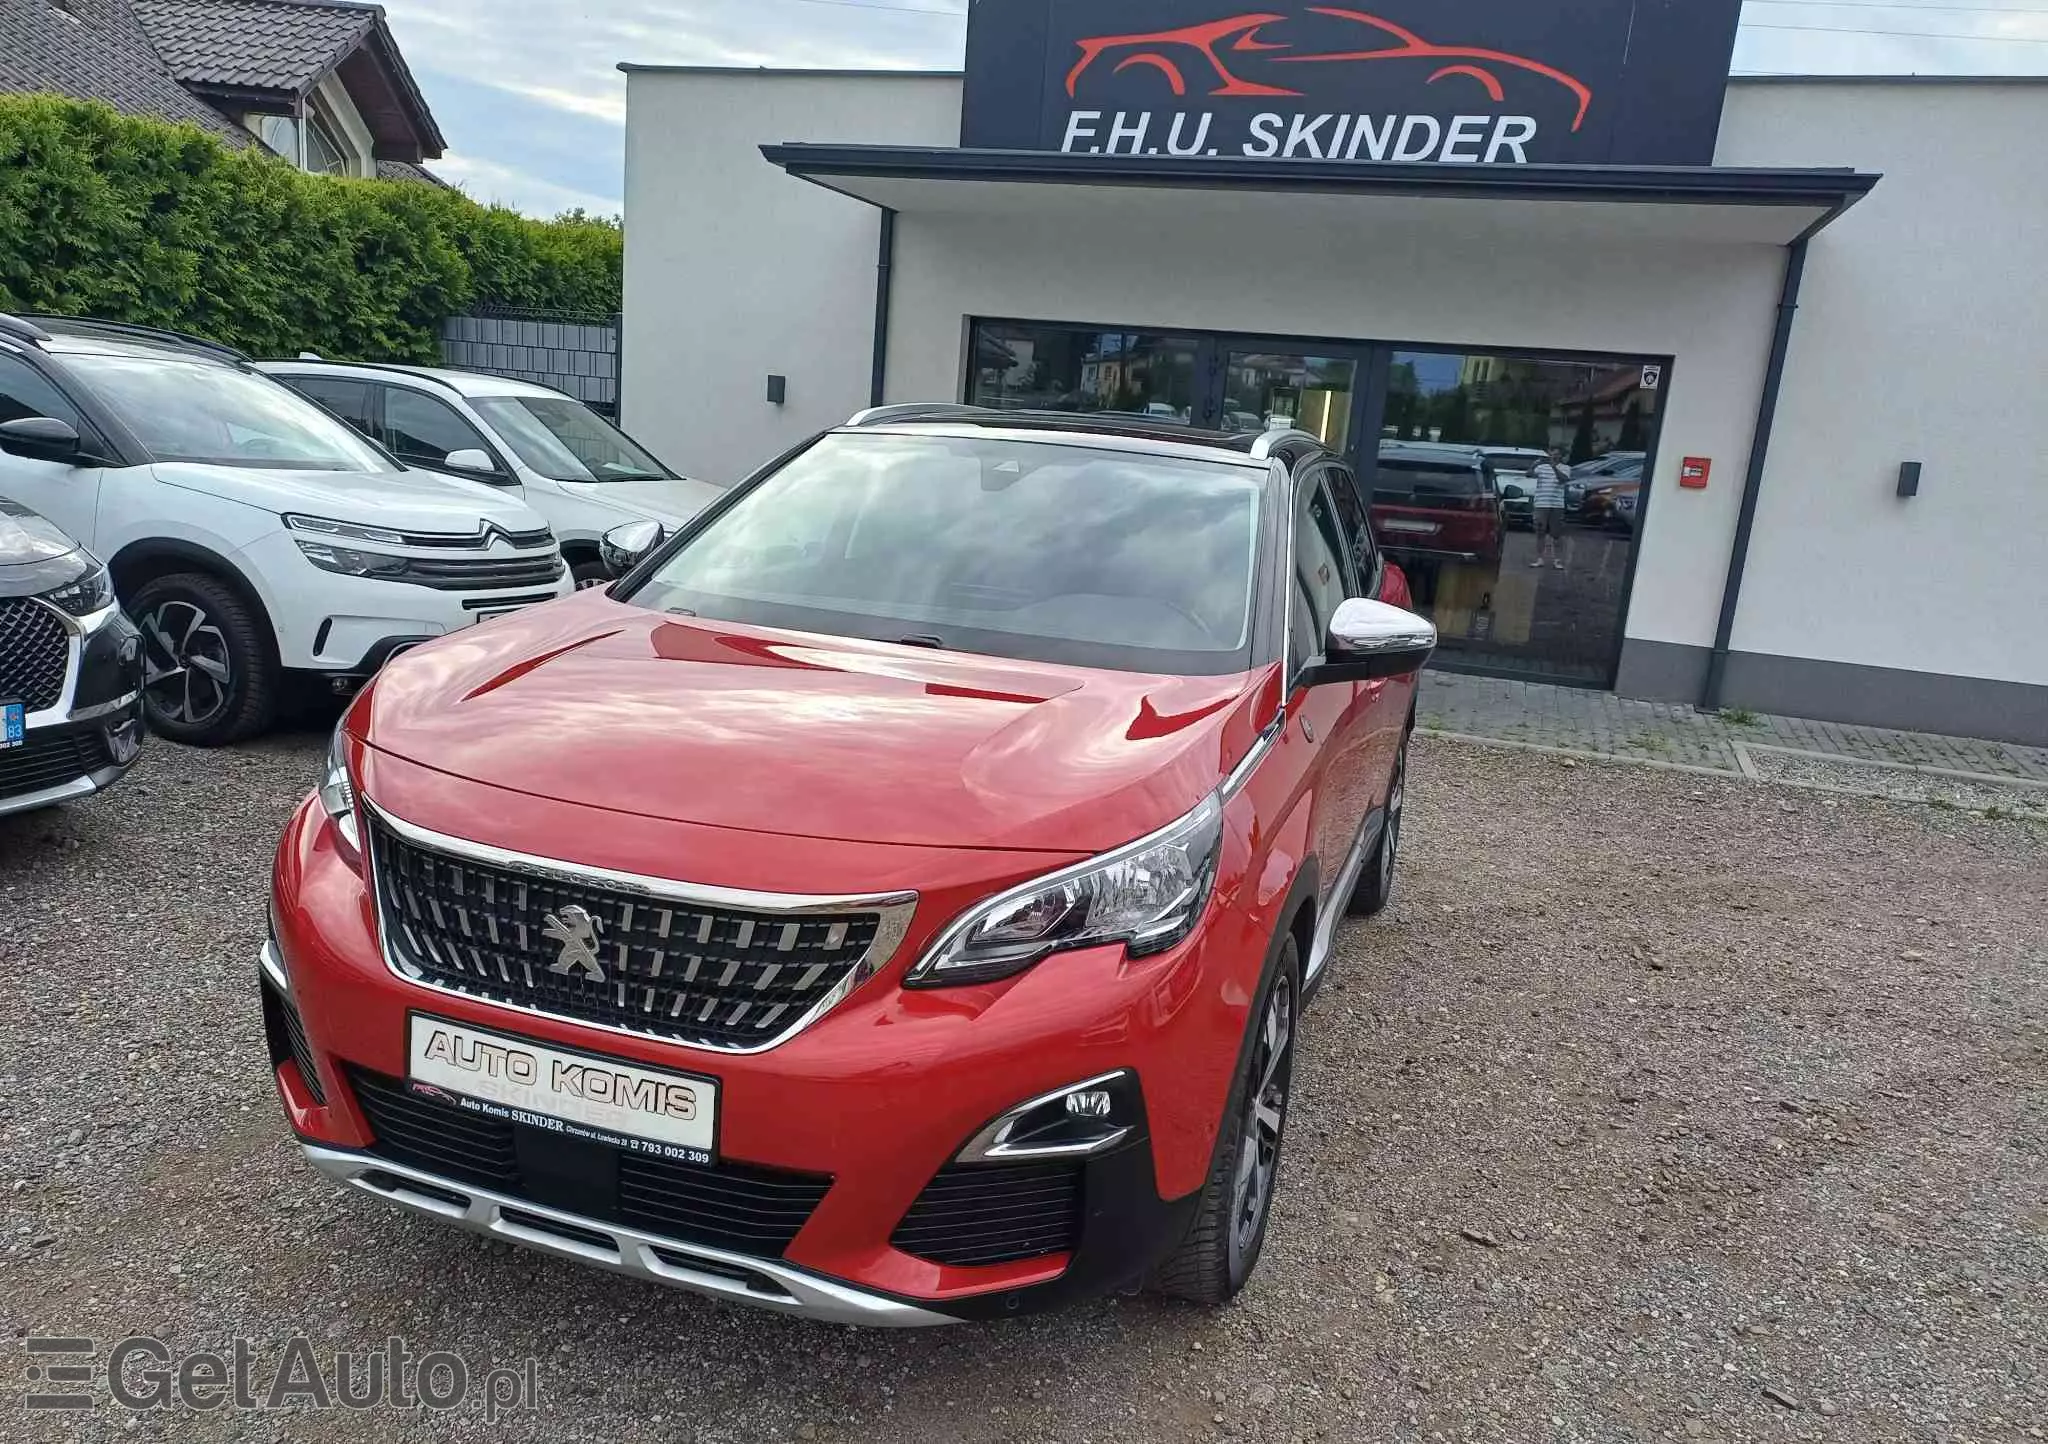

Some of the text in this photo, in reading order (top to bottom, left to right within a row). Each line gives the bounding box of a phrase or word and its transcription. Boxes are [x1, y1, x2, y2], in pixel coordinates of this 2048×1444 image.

[1060, 110, 1536, 164] F.H.U. SKINDER
[424, 1031, 697, 1121] AUTO KOMIS
[460, 1097, 481, 1111] Auto
[482, 1103, 510, 1119] Komis
[511, 1110, 564, 1132] SKINDER
[641, 1141, 662, 1155] 793
[664, 1146, 685, 1159] 002
[688, 1151, 709, 1164] 309
